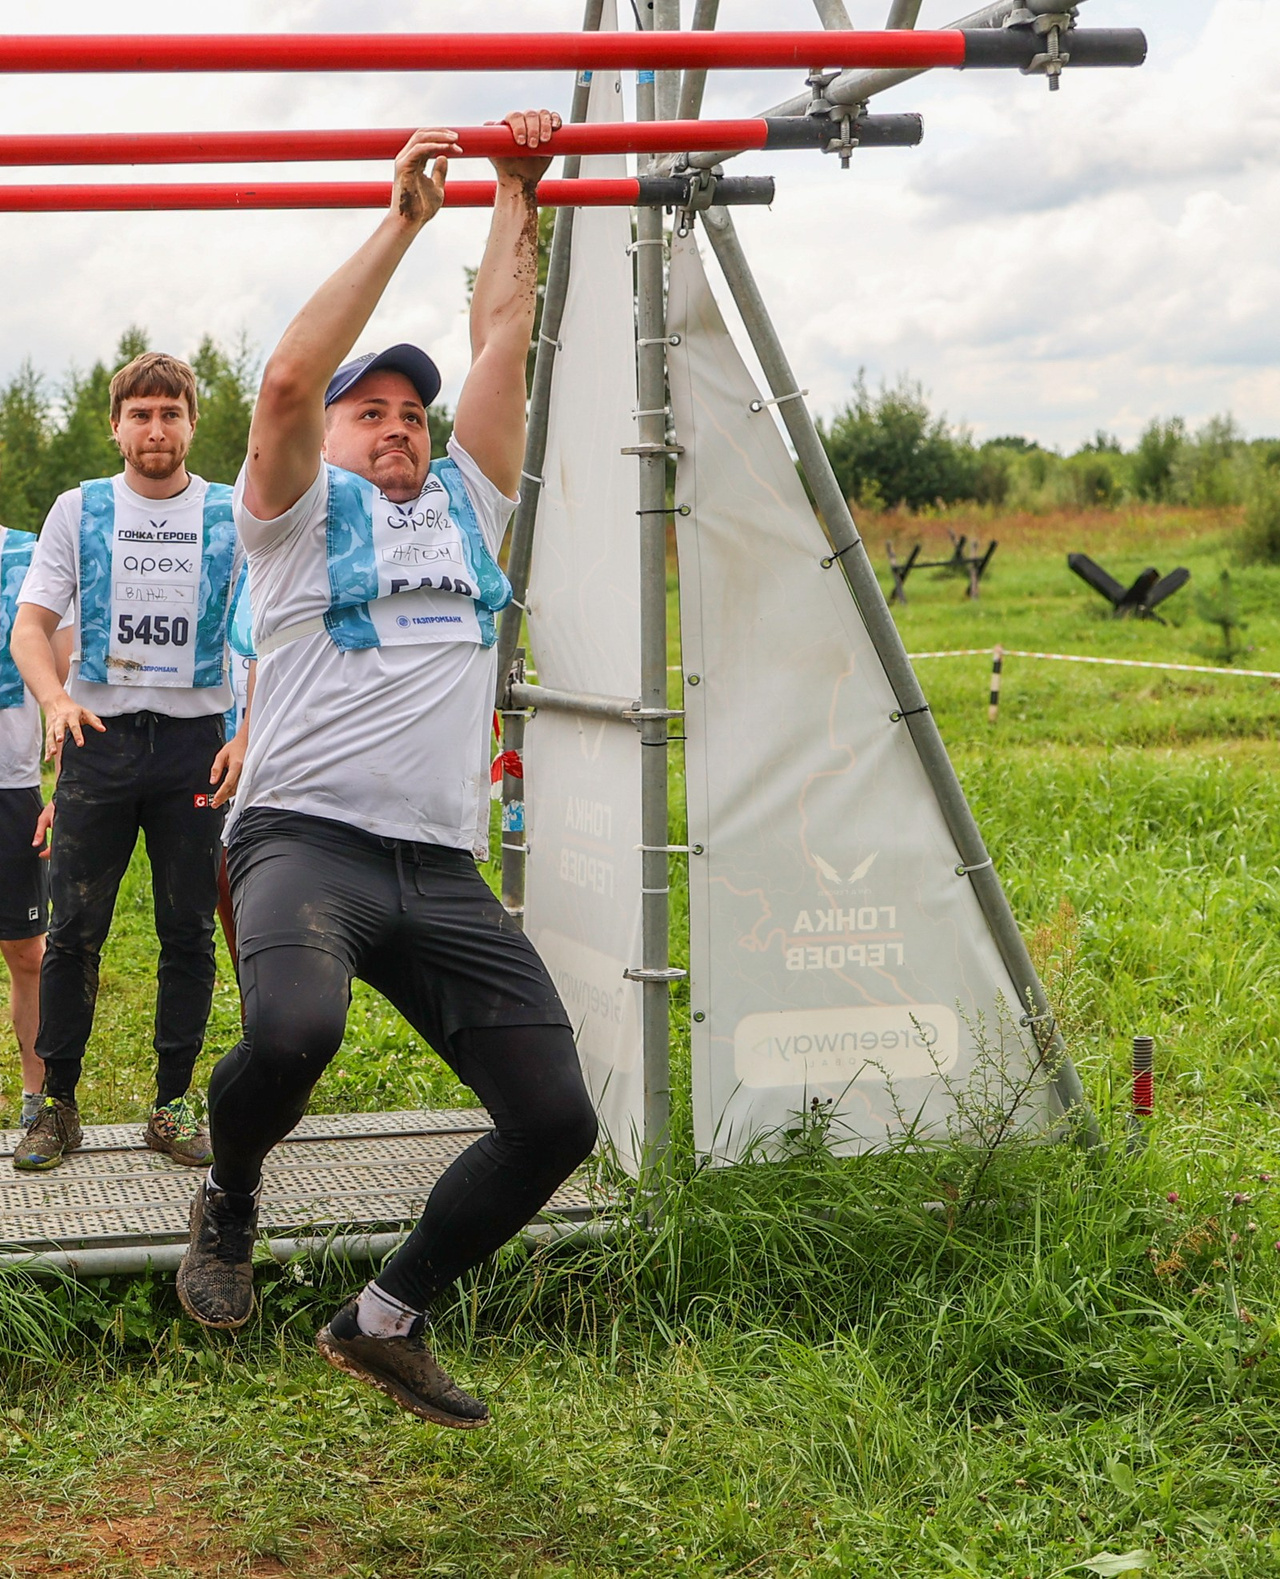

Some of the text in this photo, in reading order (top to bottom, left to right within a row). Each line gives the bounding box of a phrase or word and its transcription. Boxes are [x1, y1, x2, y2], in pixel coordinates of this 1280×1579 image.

[118, 530, 197, 541] ГОНКА ГЕРОЕВ
[412, 615, 463, 624] ГАЗПРОМБАНК
[117, 614, 189, 647] 5450
